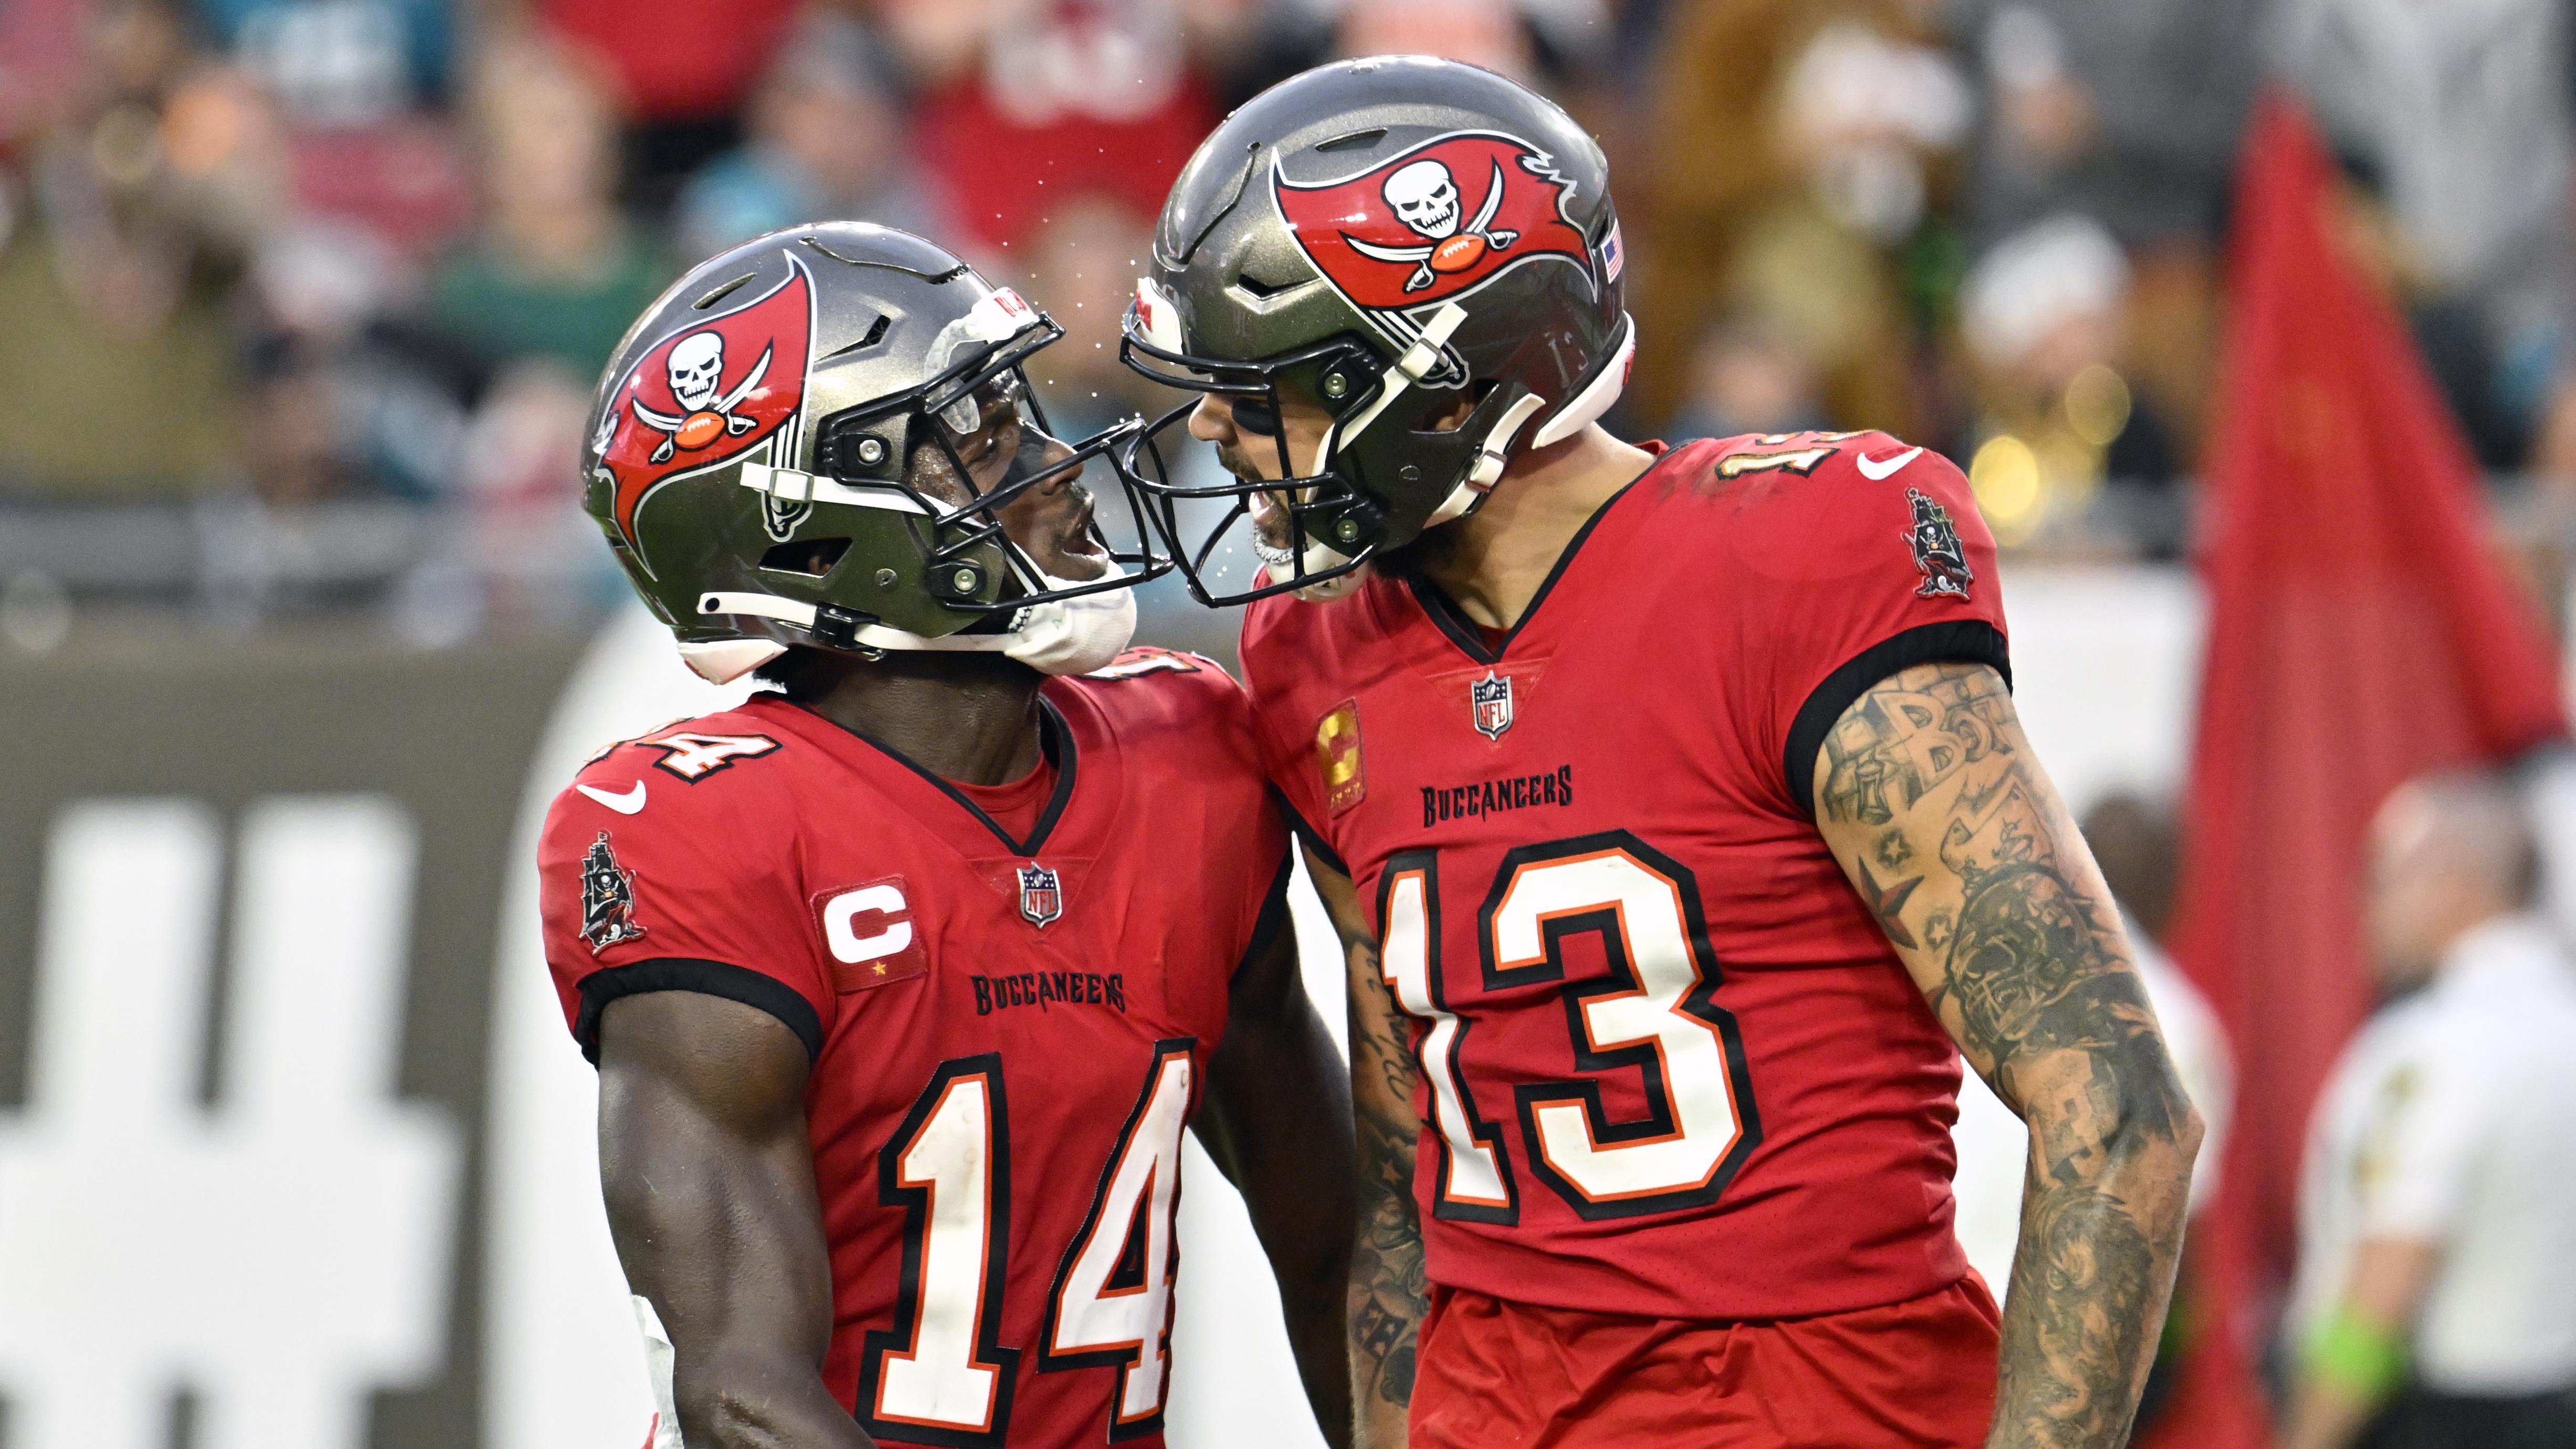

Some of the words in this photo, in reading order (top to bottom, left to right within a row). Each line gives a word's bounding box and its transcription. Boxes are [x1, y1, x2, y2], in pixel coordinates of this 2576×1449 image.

[1479, 702, 1505, 728] NFL
[1421, 764, 1572, 829] BUCCANEERS
[824, 885, 912, 964] C
[1028, 891, 1055, 915] NFL
[1376, 828, 1764, 1227] 13
[854, 1036, 1198, 1448] 14
